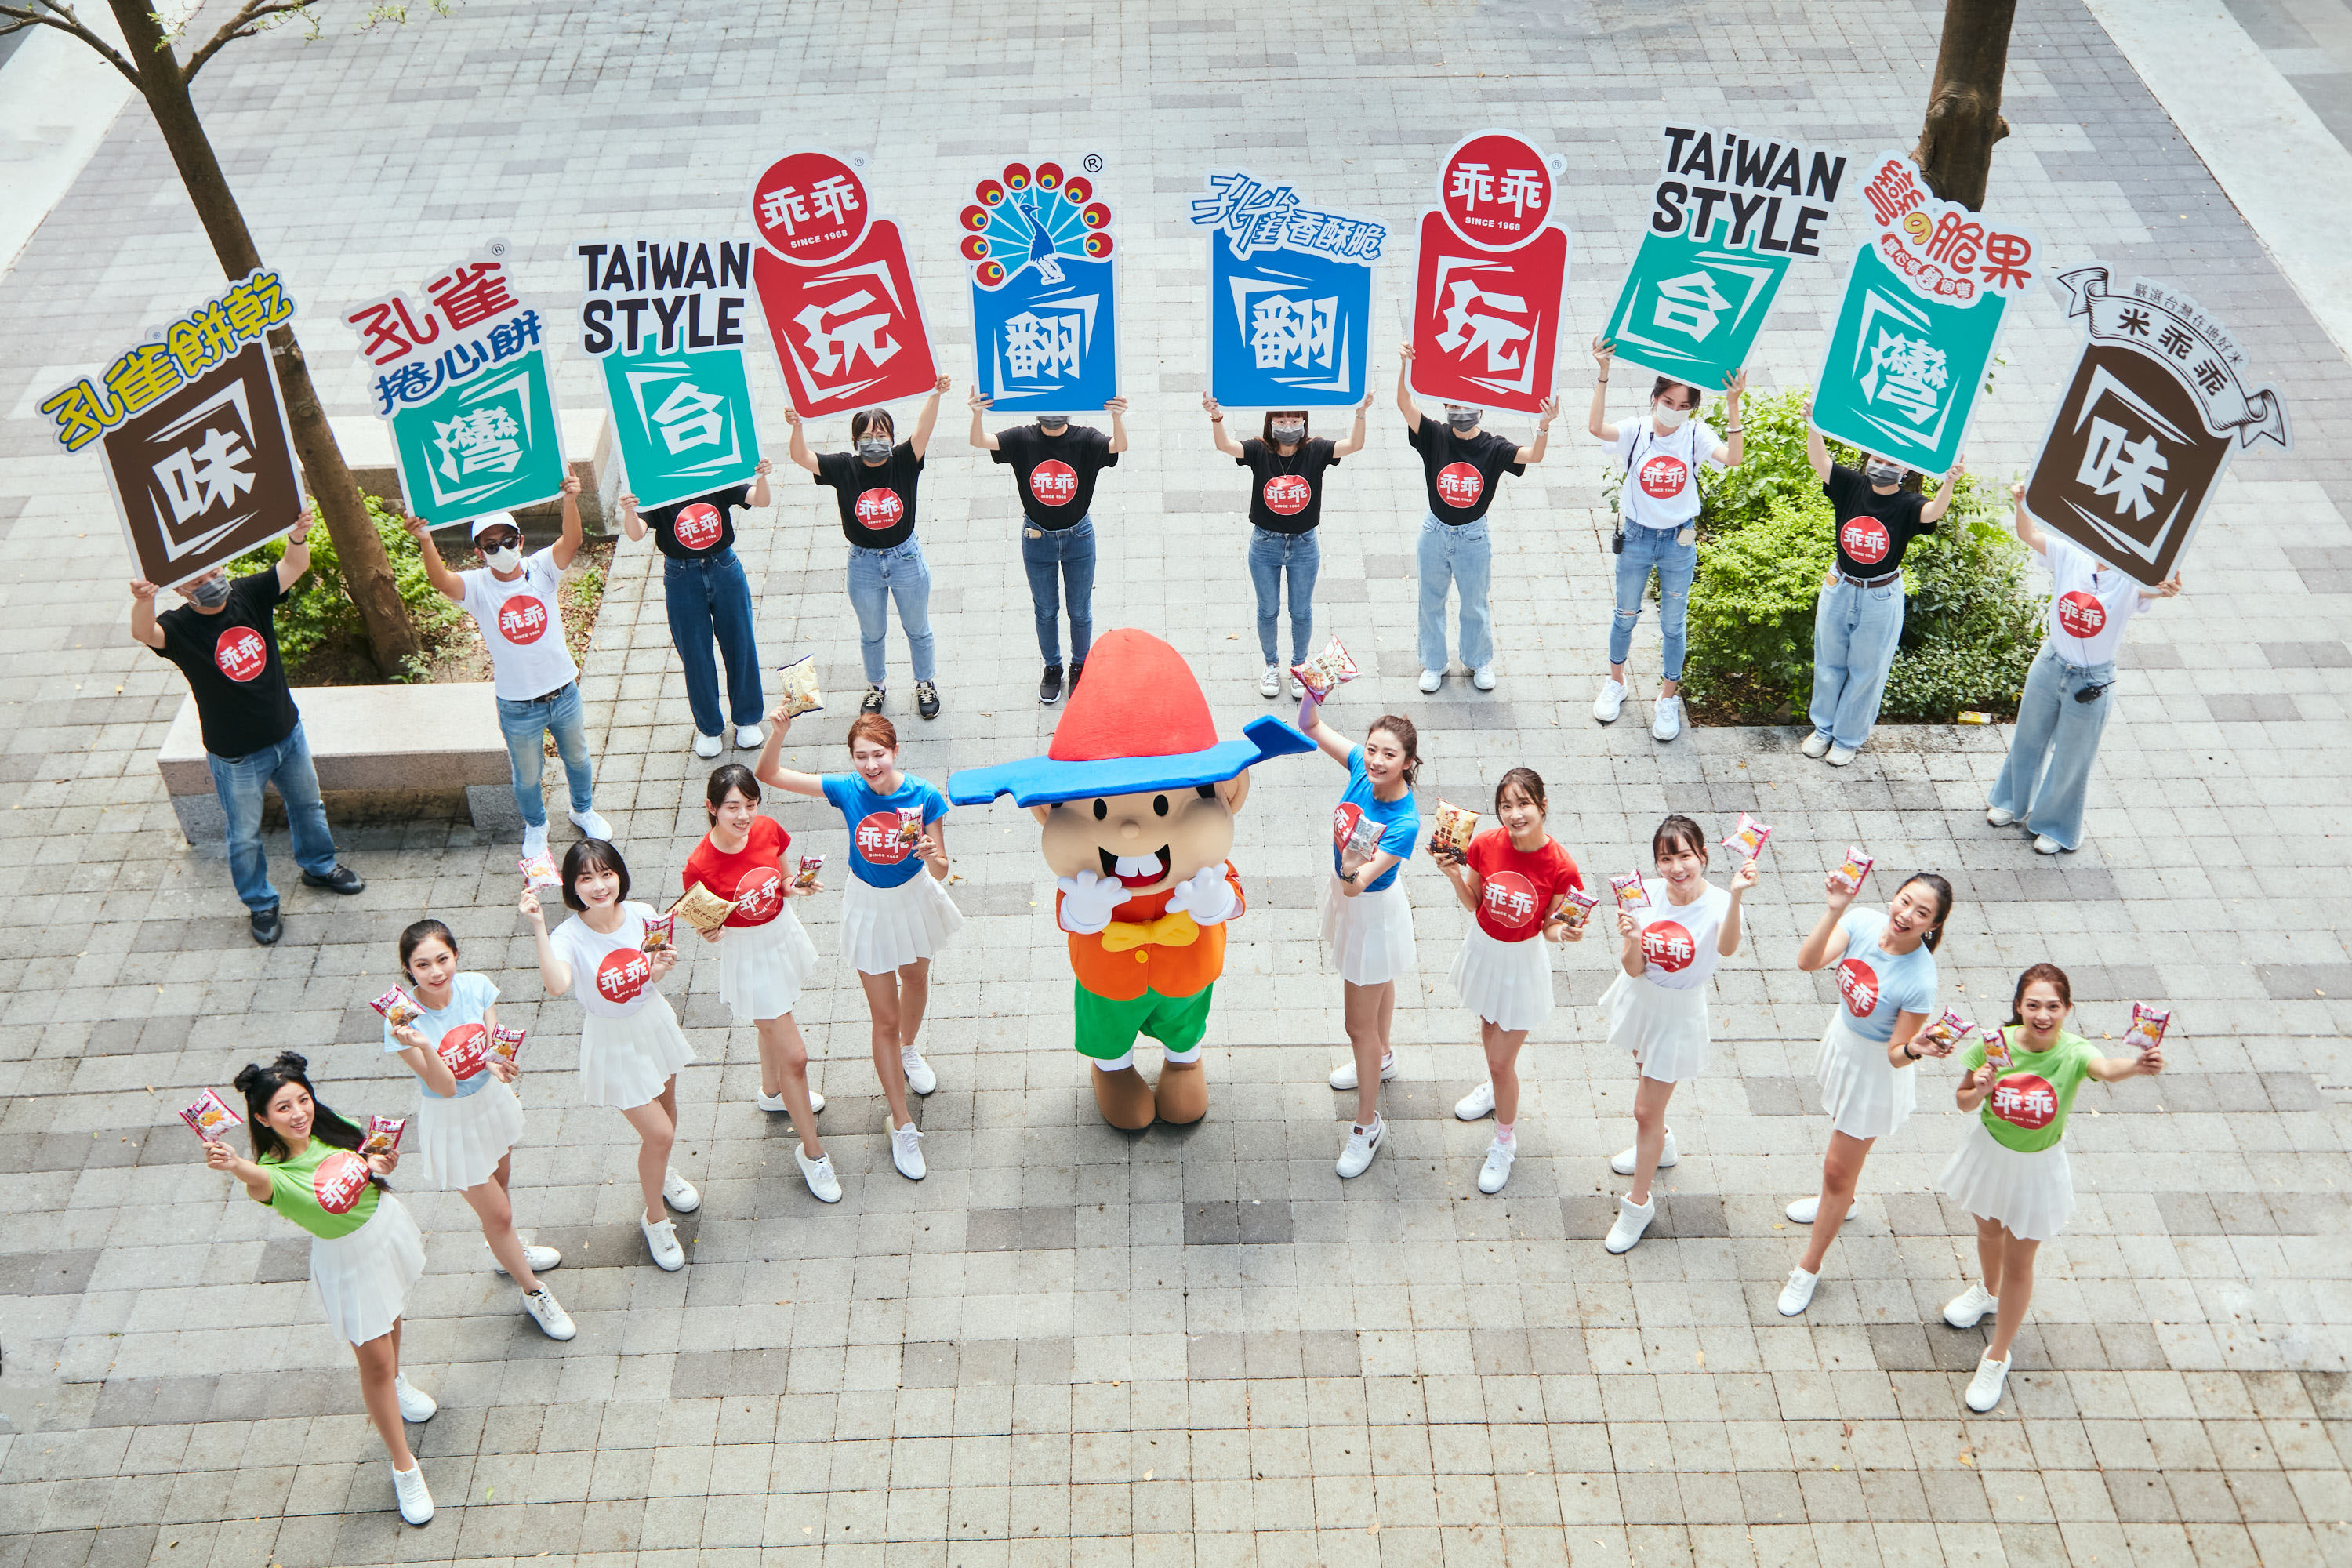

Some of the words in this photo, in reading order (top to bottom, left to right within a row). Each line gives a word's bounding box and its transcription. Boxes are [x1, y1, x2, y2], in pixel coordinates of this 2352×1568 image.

[760, 174, 860, 236] 乖乖
[1450, 162, 1544, 218] 乖乖
[1651, 180, 1829, 256] STYLE
[790, 235, 822, 249] SINCE
[824, 229, 848, 242] 1968
[1465, 216, 1495, 229] SINCE
[1497, 220, 1521, 232] 1968
[348, 262, 519, 365] 孔雀
[583, 293, 745, 354] STYLE
[793, 289, 902, 378] 玩
[1250, 294, 1338, 370] 翻
[1435, 278, 1532, 372] 玩
[1653, 270, 1733, 343] 台
[2134, 282, 2243, 365] 嚴選台灣在地好米
[41, 272, 294, 452] 孔雀餅乾
[375, 310, 542, 415] 捲心餅
[1004, 310, 1081, 379] 翻
[2117, 308, 2228, 397] 米乖乖
[1859, 326, 1949, 426] 灣
[432, 405, 524, 484] 灣
[651, 381, 725, 456] 台
[152, 428, 256, 525] 味
[1033, 473, 1074, 494] 乖乖
[1267, 484, 1307, 503] 乖乖
[1439, 474, 1480, 497] 乖乖
[1642, 466, 1685, 487] 乖乖
[2076, 416, 2169, 521] 味
[678, 511, 719, 539] 乖乖
[858, 496, 900, 520] 乖乖
[1843, 527, 1886, 554] 乖乖
[501, 604, 546, 634] 乖乖
[2060, 597, 2103, 629] 乖乖
[219, 634, 263, 670] 乖乖
[1484, 882, 1534, 917] 乖乖
[600, 957, 648, 993] 乖乖
[1642, 932, 1691, 962] 乖乖
[1837, 964, 1874, 1011] 乖乖
[1993, 1087, 2054, 1119] 乖乖
[320, 1157, 369, 1208] 乖乖
